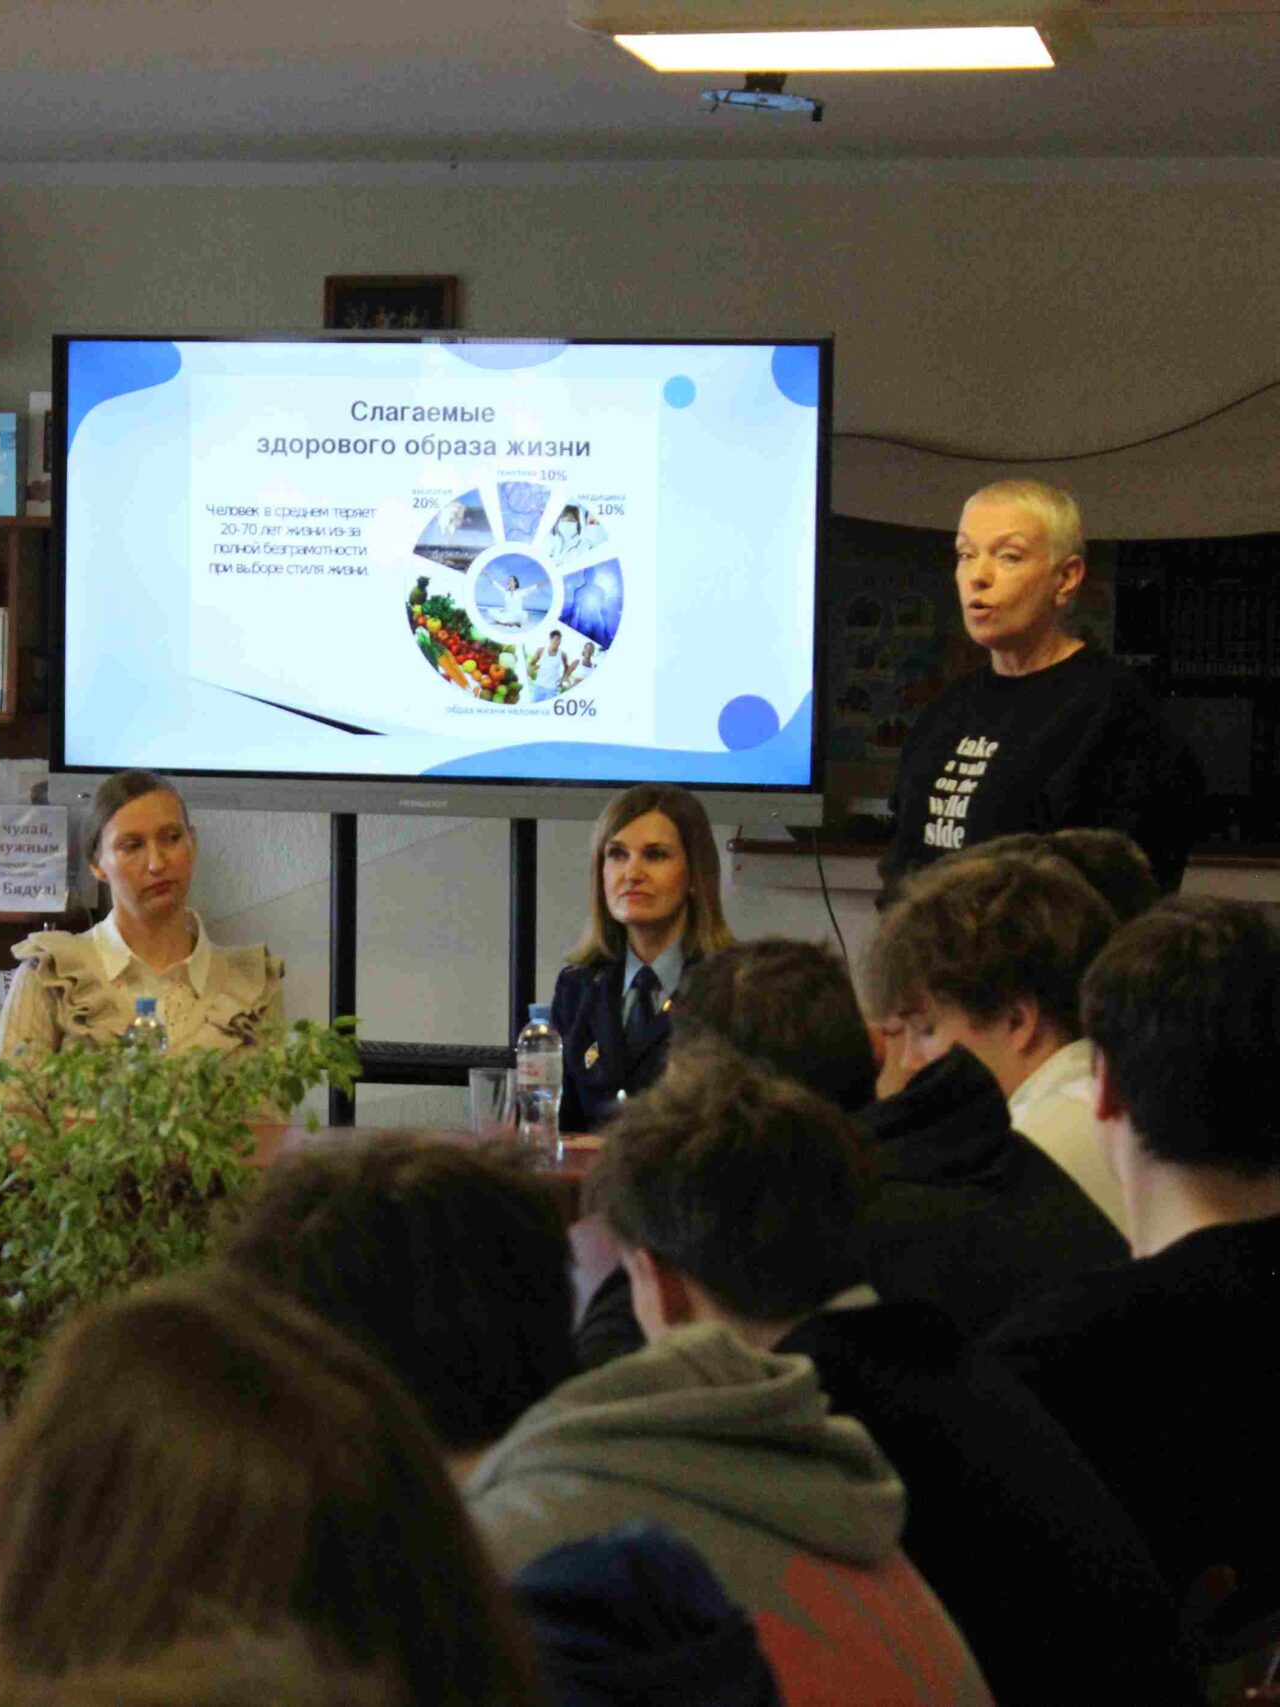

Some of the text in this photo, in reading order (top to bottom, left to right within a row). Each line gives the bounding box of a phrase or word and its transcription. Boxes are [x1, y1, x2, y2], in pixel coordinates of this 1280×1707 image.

[350, 400, 496, 423] Слагаемые
[256, 433, 591, 461] здорового образа жизни
[540, 469, 568, 482] 10%
[206, 503, 377, 520] Человек в среднем теряет
[412, 497, 440, 509] 20%
[597, 503, 625, 516] 10%
[220, 522, 362, 537] 20-70 лет жизни из-за
[214, 541, 368, 558] полной безграмотности
[209, 560, 370, 576] при выборе стиля жизни.
[553, 699, 597, 717] 60%
[956, 735, 1000, 758] take
[934, 776, 958, 792] on
[928, 794, 971, 819] wild
[2, 821, 53, 838] чулай,
[923, 817, 966, 850] side
